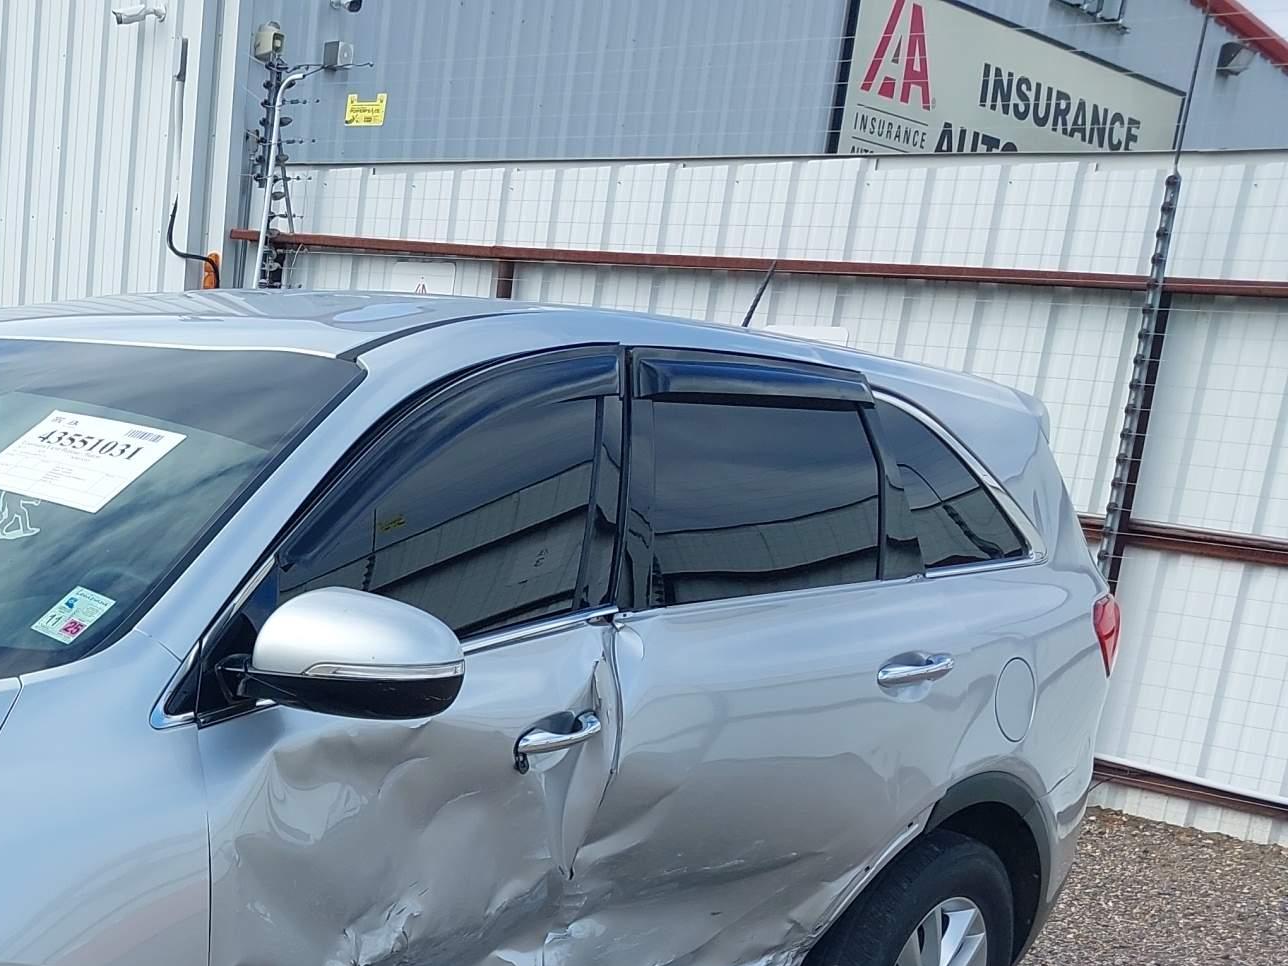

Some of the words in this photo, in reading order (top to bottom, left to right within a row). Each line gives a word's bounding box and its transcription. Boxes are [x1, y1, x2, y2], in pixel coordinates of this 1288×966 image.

[979, 62, 1142, 151] INSURANCE
[853, 111, 928, 149] INSURANCE
[38, 430, 145, 460] 43551031
[63, 620, 84, 635] 25
